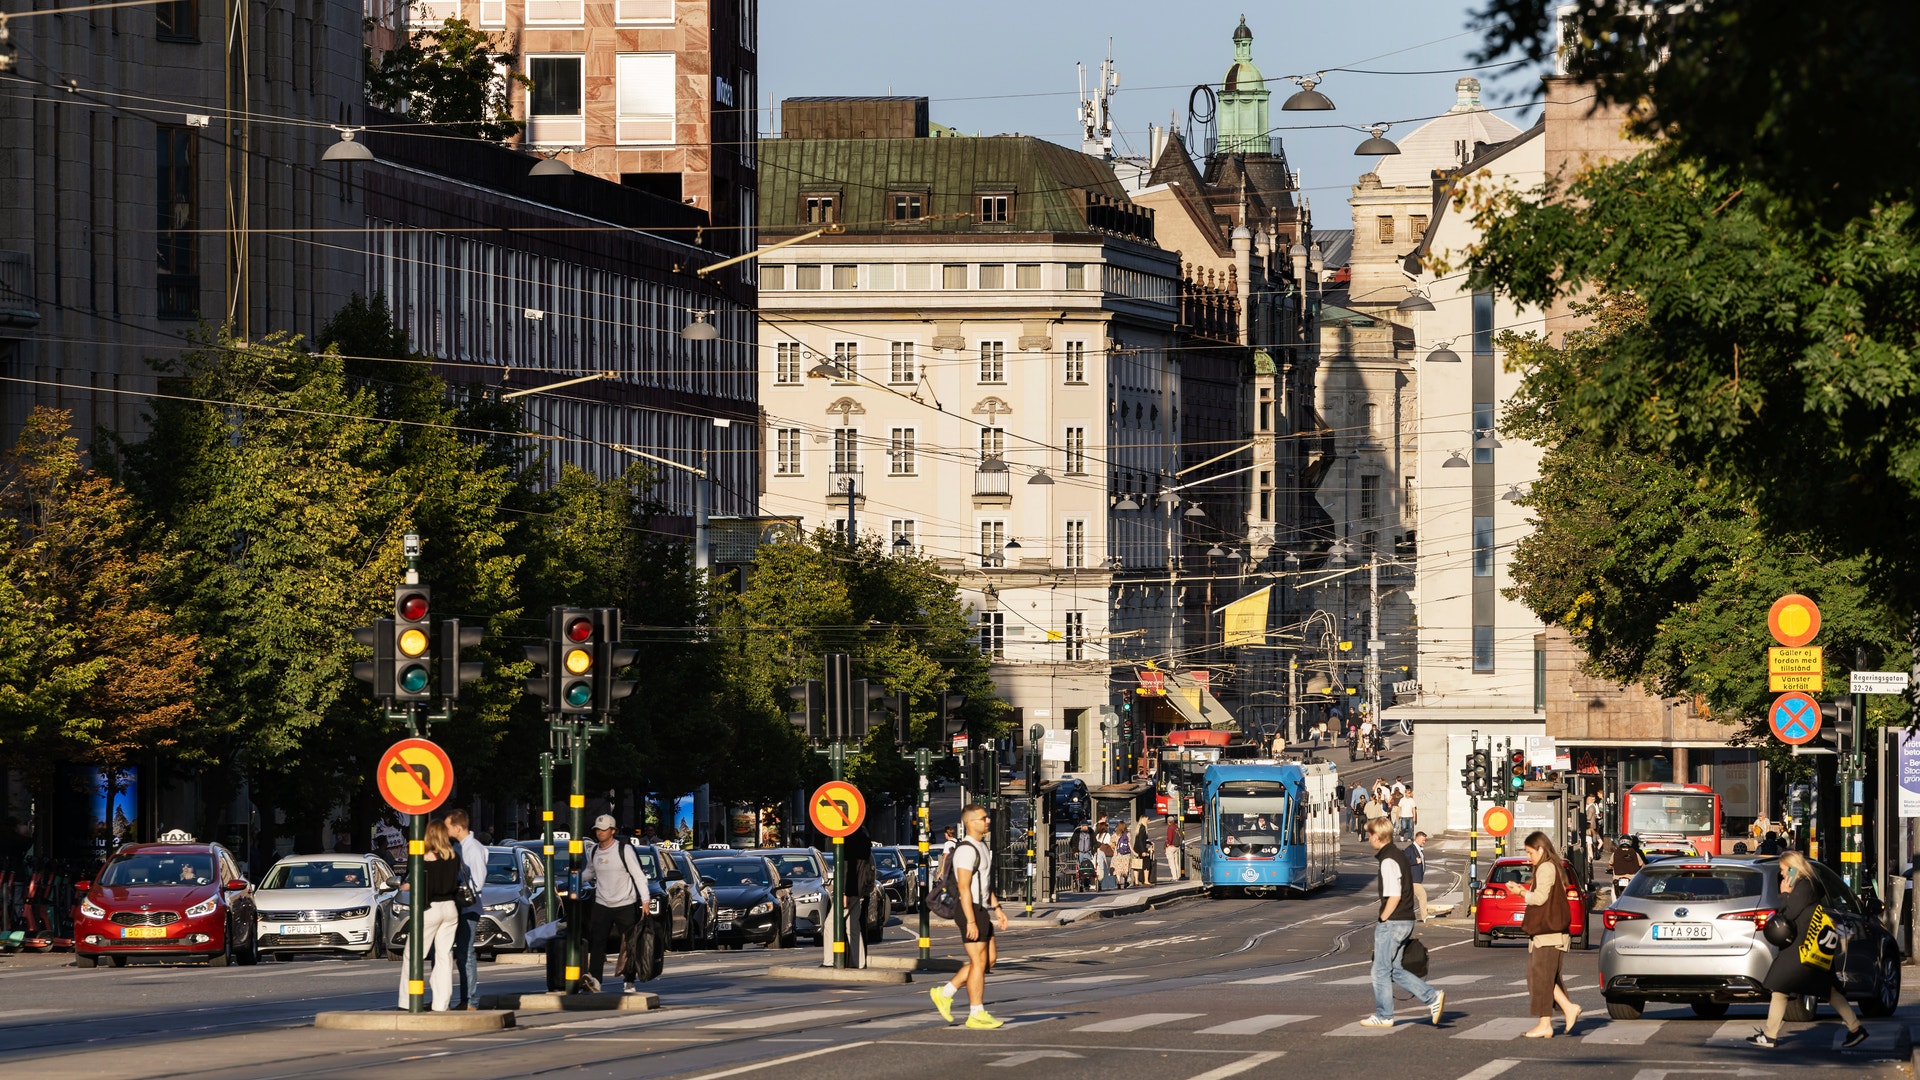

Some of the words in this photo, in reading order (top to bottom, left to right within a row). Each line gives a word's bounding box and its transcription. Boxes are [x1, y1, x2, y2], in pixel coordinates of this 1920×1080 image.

[1853, 674, 1904, 683] Regeringsgatan
[1853, 684, 1873, 692] 32-26
[162, 833, 191, 841] TAXI
[1662, 926, 1682, 937] TYA
[1686, 926, 1707, 937] 98G
[1818, 930, 1839, 949] JD
